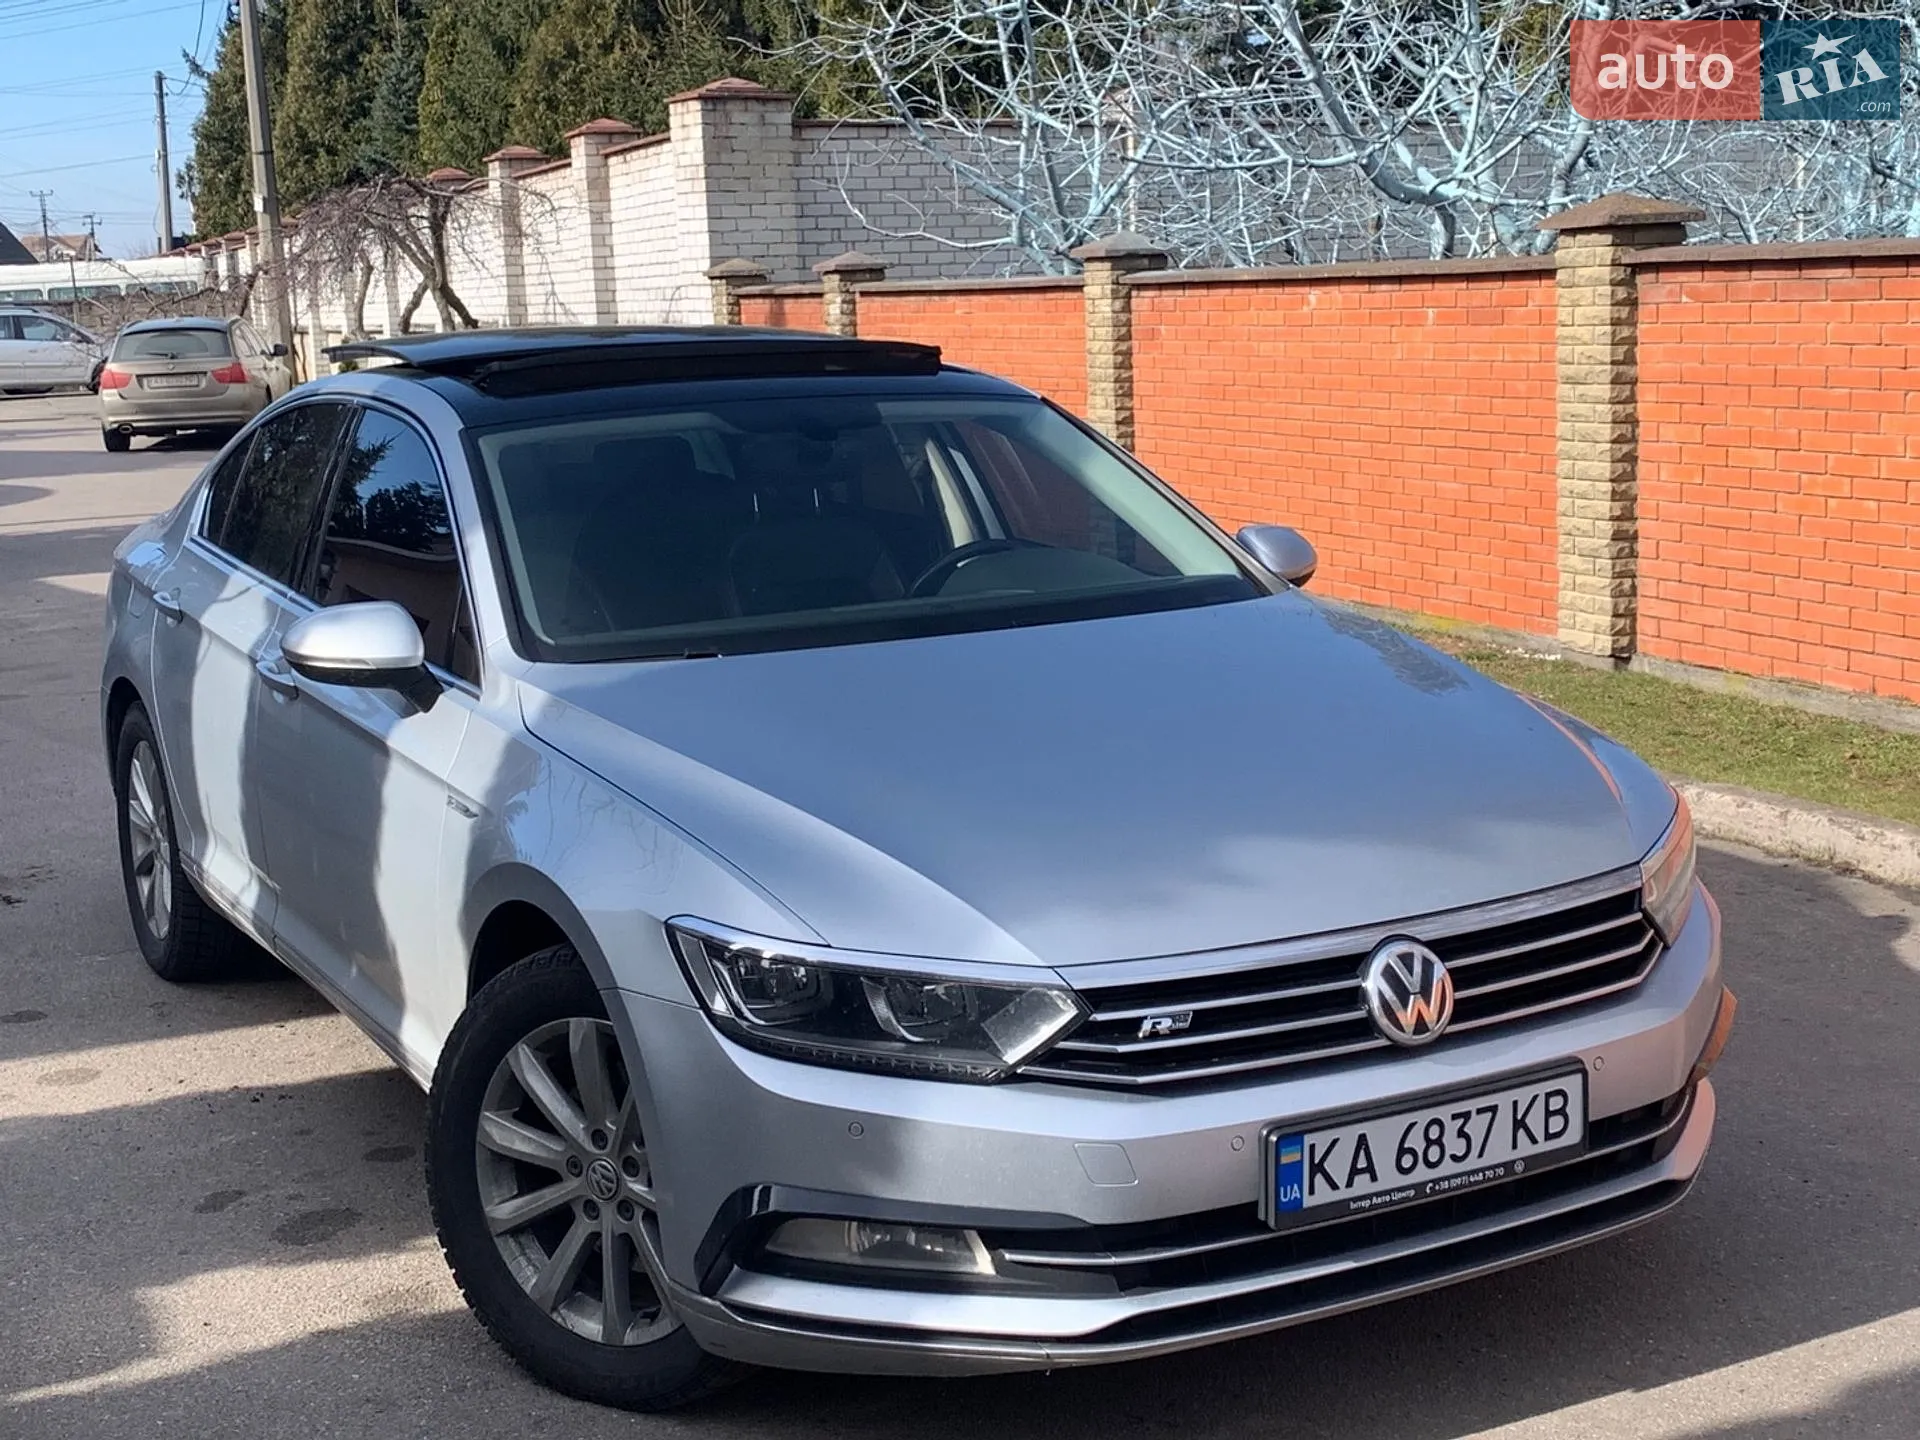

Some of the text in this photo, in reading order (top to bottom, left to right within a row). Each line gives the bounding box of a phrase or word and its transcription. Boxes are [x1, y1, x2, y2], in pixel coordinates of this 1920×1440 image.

[1308, 1087, 1570, 1195] KA 6837 KB
[1280, 1183, 1301, 1202] UA
[1372, 1194, 1391, 1206] Авто
[1391, 1188, 1416, 1201] Центр
